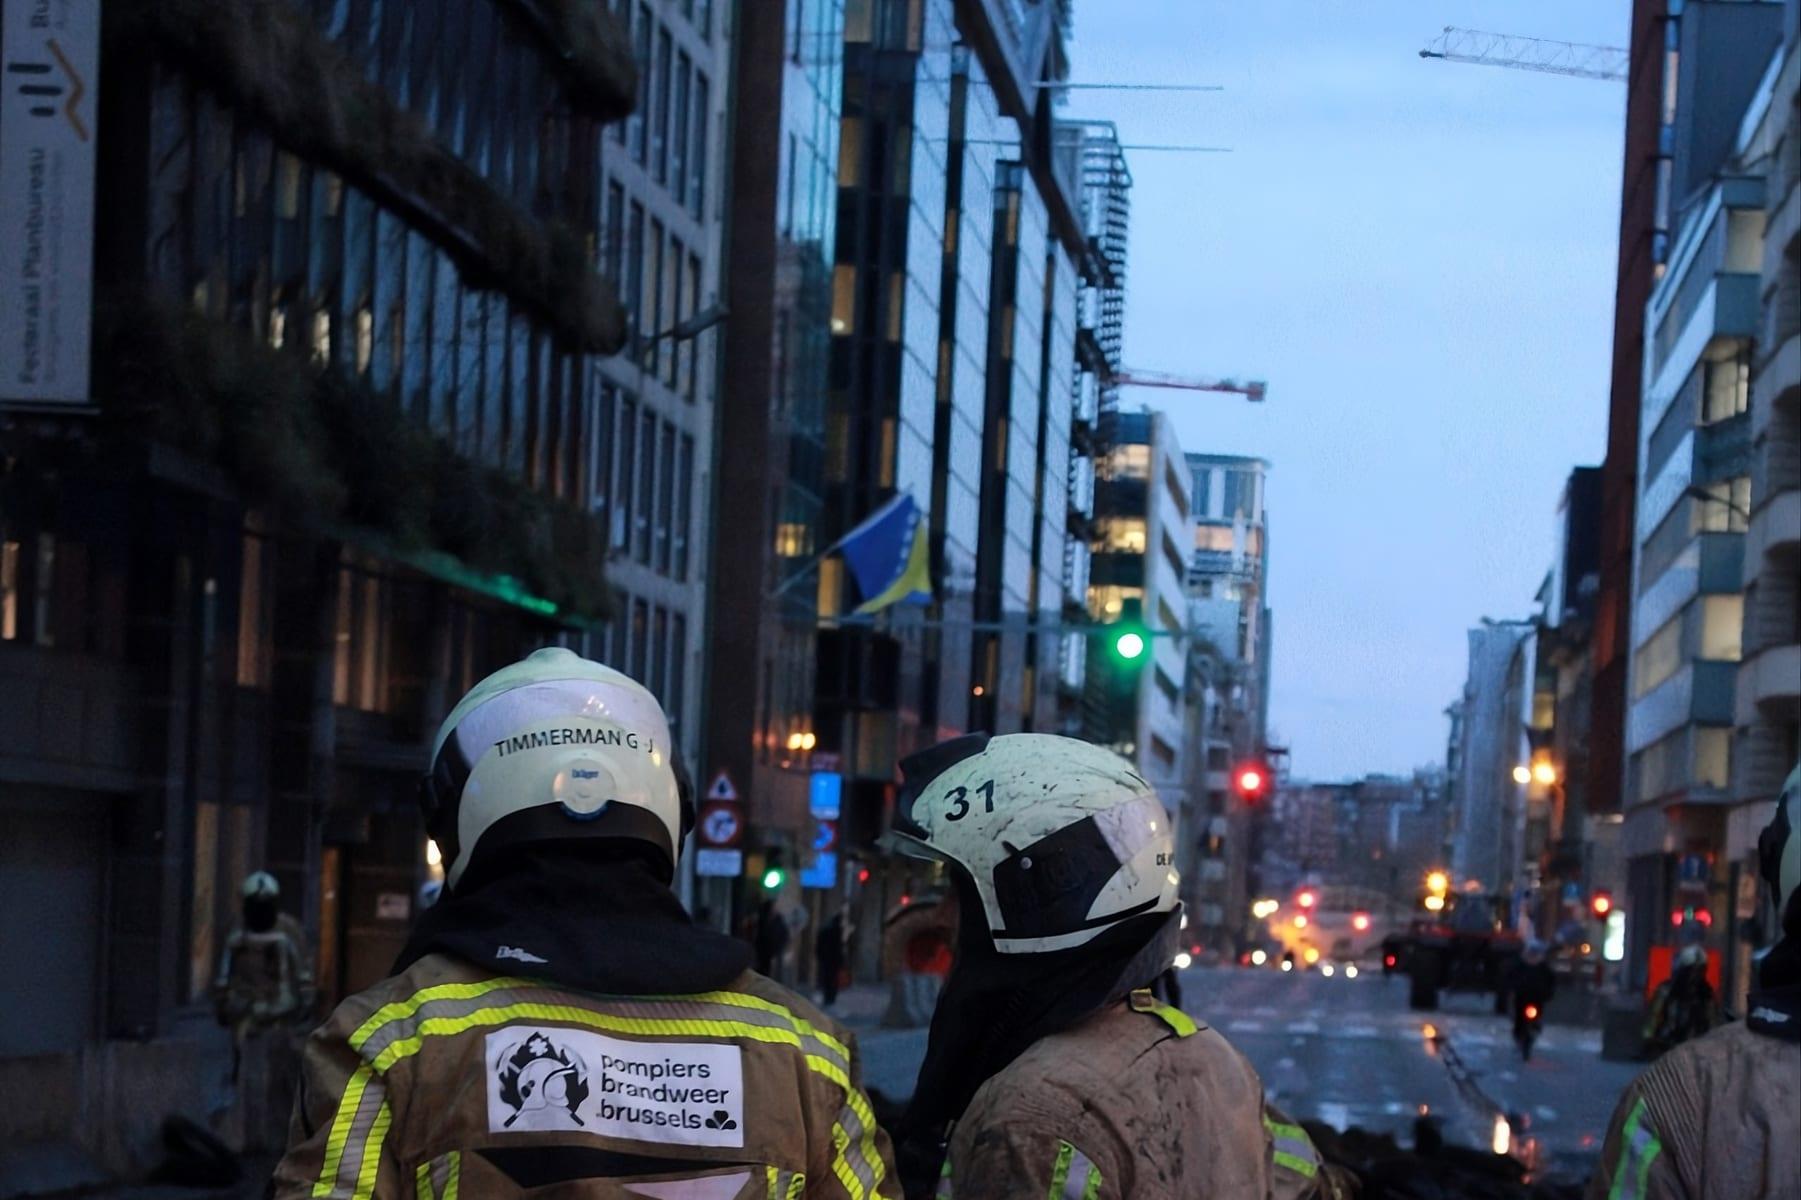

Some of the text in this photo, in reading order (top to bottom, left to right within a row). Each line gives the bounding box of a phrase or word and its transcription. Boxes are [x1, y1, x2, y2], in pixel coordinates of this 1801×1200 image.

[22, 148, 45, 278] Planbureau
[494, 728, 621, 757] TIMMERMAN
[600, 1054, 711, 1081] pompiers
[601, 1072, 729, 1104] brandweer
